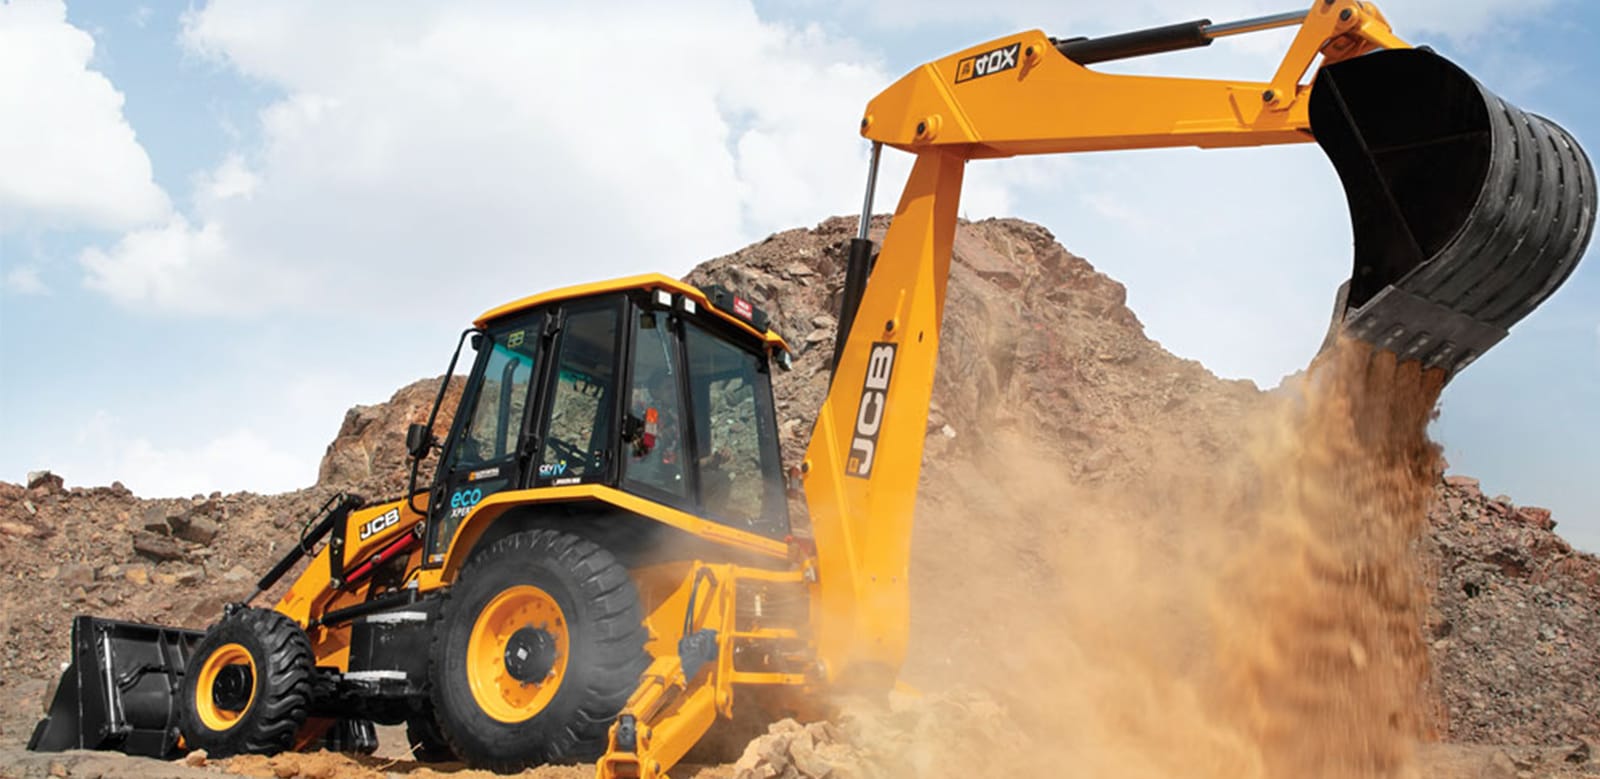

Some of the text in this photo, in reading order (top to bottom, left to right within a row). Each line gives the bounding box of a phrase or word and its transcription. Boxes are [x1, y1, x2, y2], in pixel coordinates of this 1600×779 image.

[853, 345, 894, 475] JCB
[451, 488, 481, 508] eco
[361, 509, 400, 539] JCB
